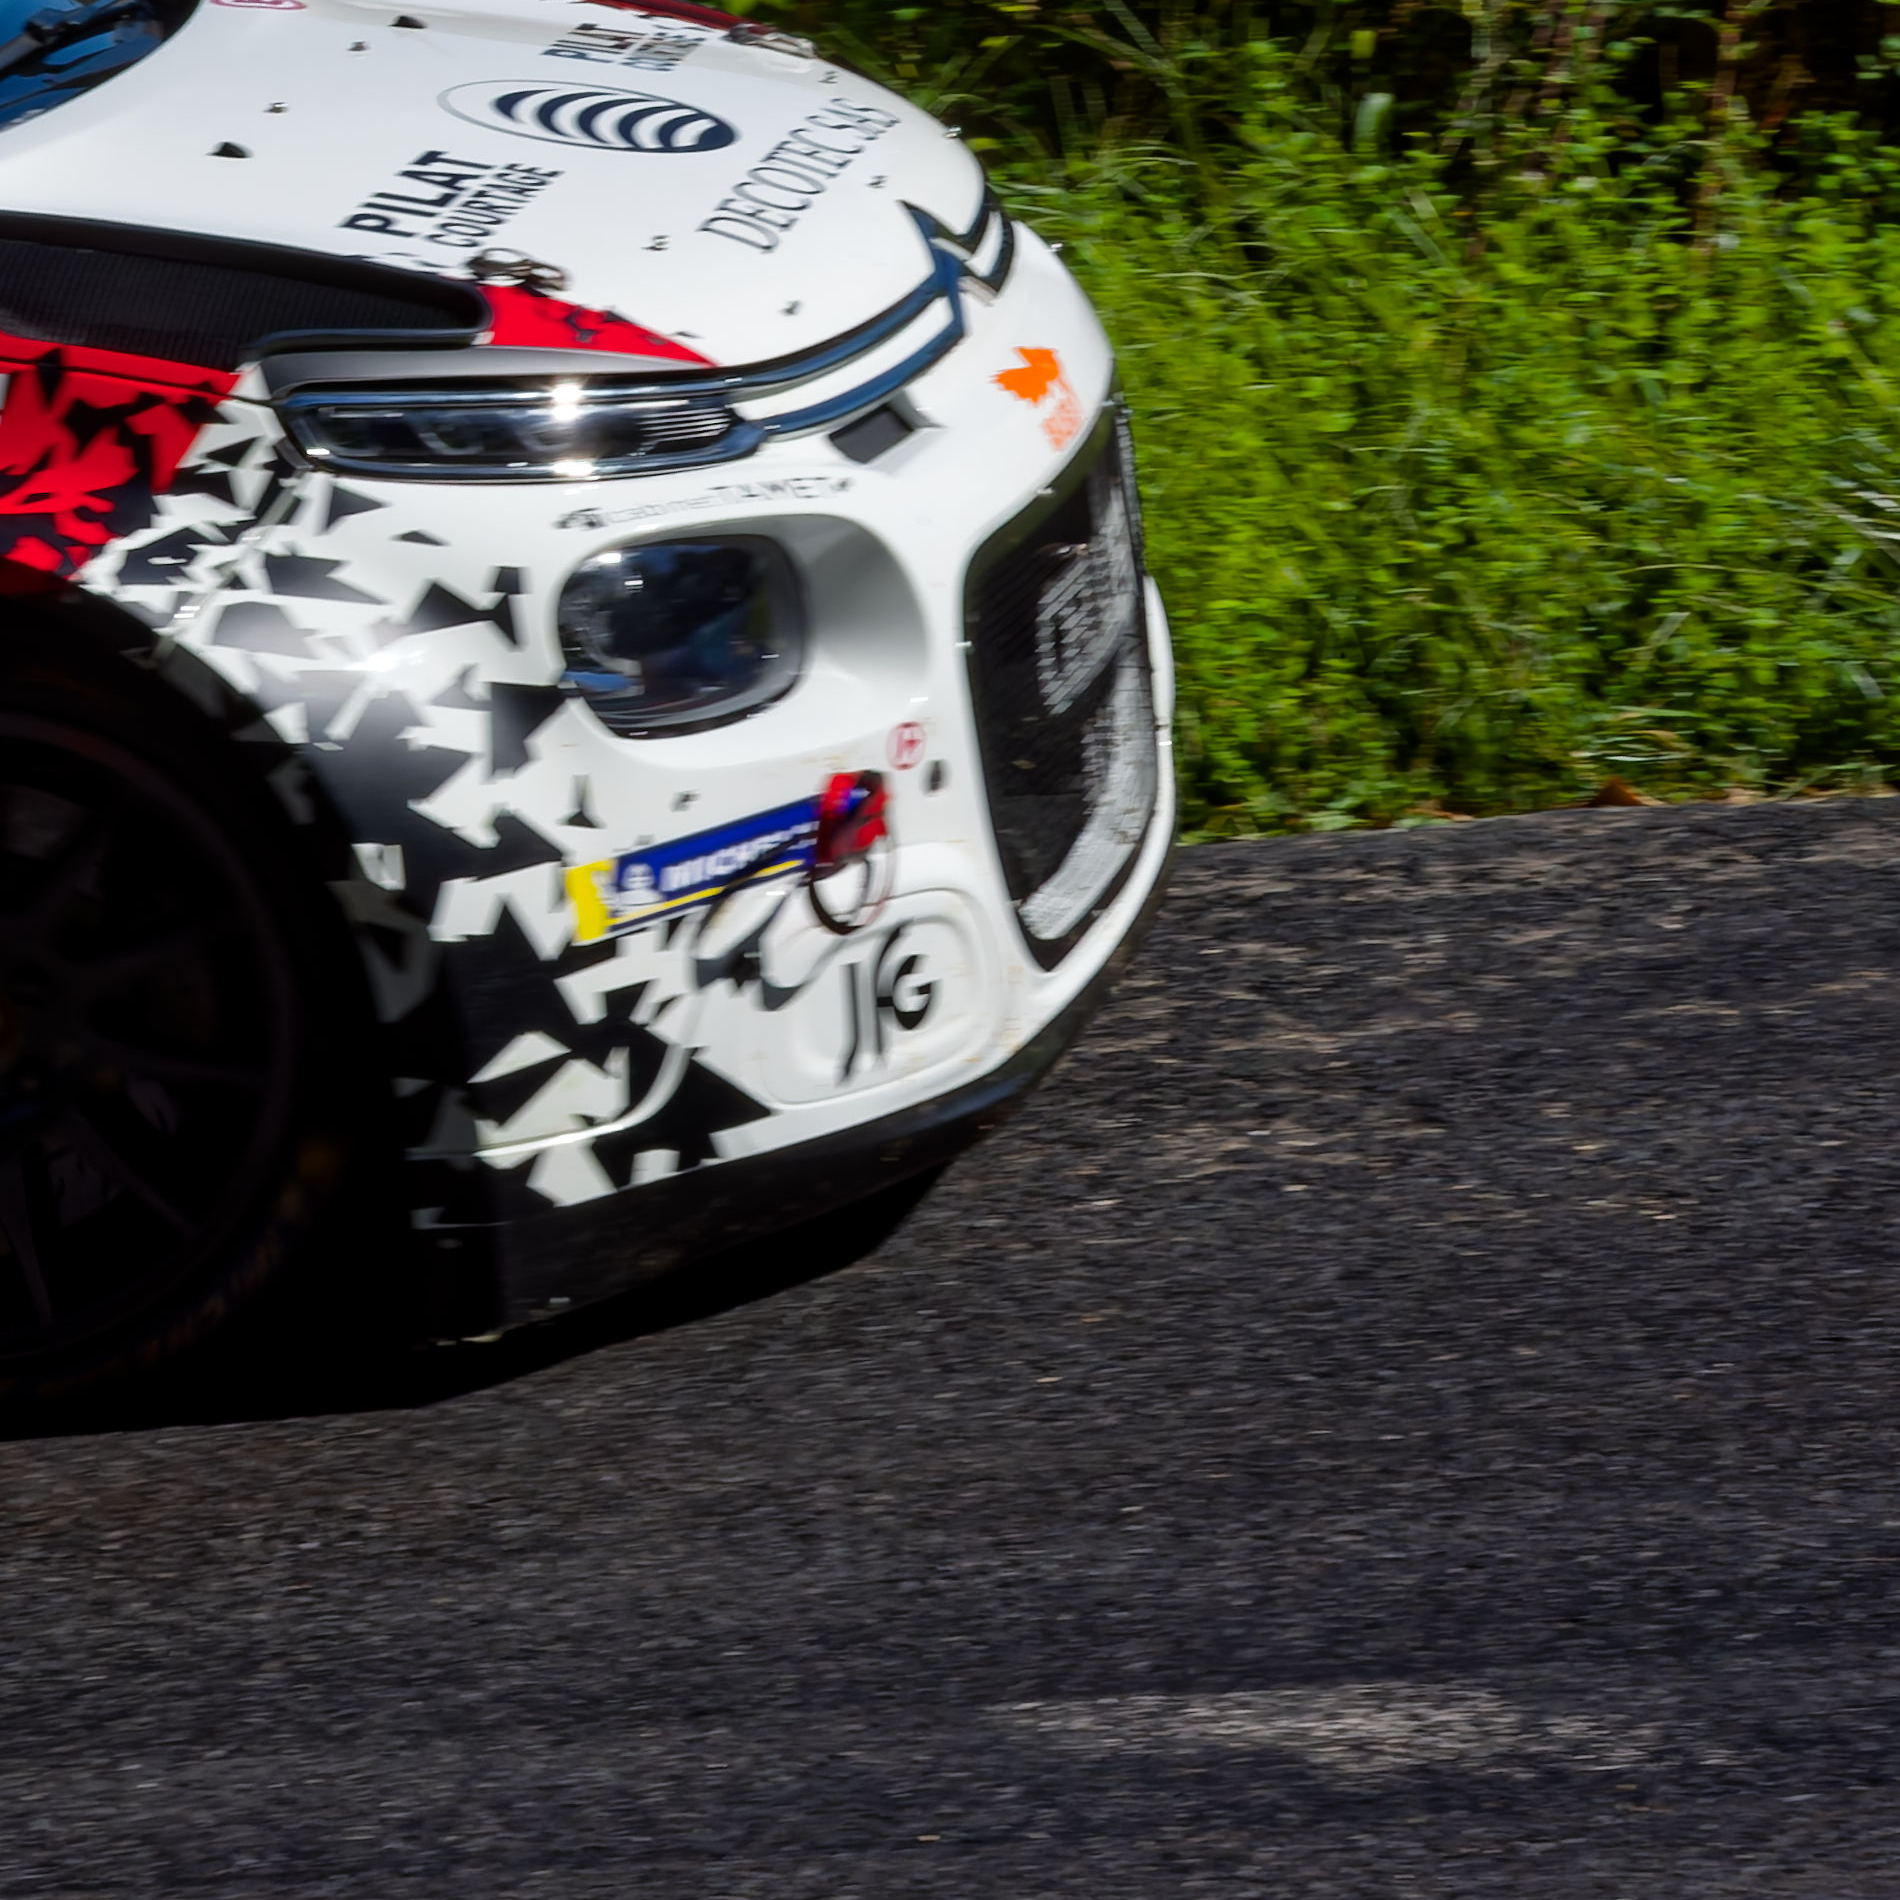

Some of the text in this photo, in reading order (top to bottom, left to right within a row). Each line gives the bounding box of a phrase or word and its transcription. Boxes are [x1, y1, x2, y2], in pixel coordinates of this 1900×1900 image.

[336, 149, 498, 238] PILAT
[424, 162, 568, 249] COURTAGE
[695, 97, 902, 253] DECOTEC SAS
